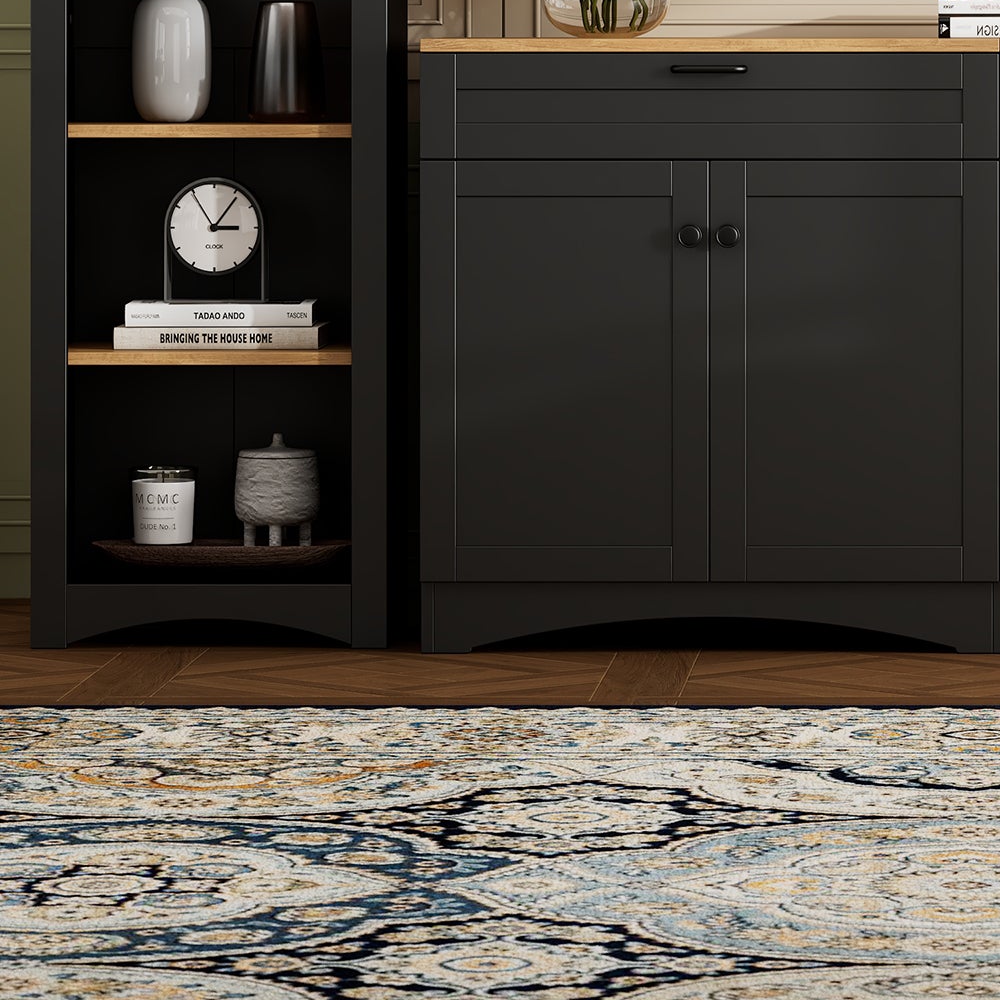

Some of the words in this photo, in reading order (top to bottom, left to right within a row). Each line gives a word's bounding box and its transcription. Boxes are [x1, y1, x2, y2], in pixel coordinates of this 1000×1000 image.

[193, 311, 221, 320] TADAO
[222, 311, 245, 320] ANDO
[159, 333, 200, 344] BRINGING
[202, 333, 218, 344] THE
[220, 333, 248, 344] HOUSE
[250, 333, 273, 344] HOME
